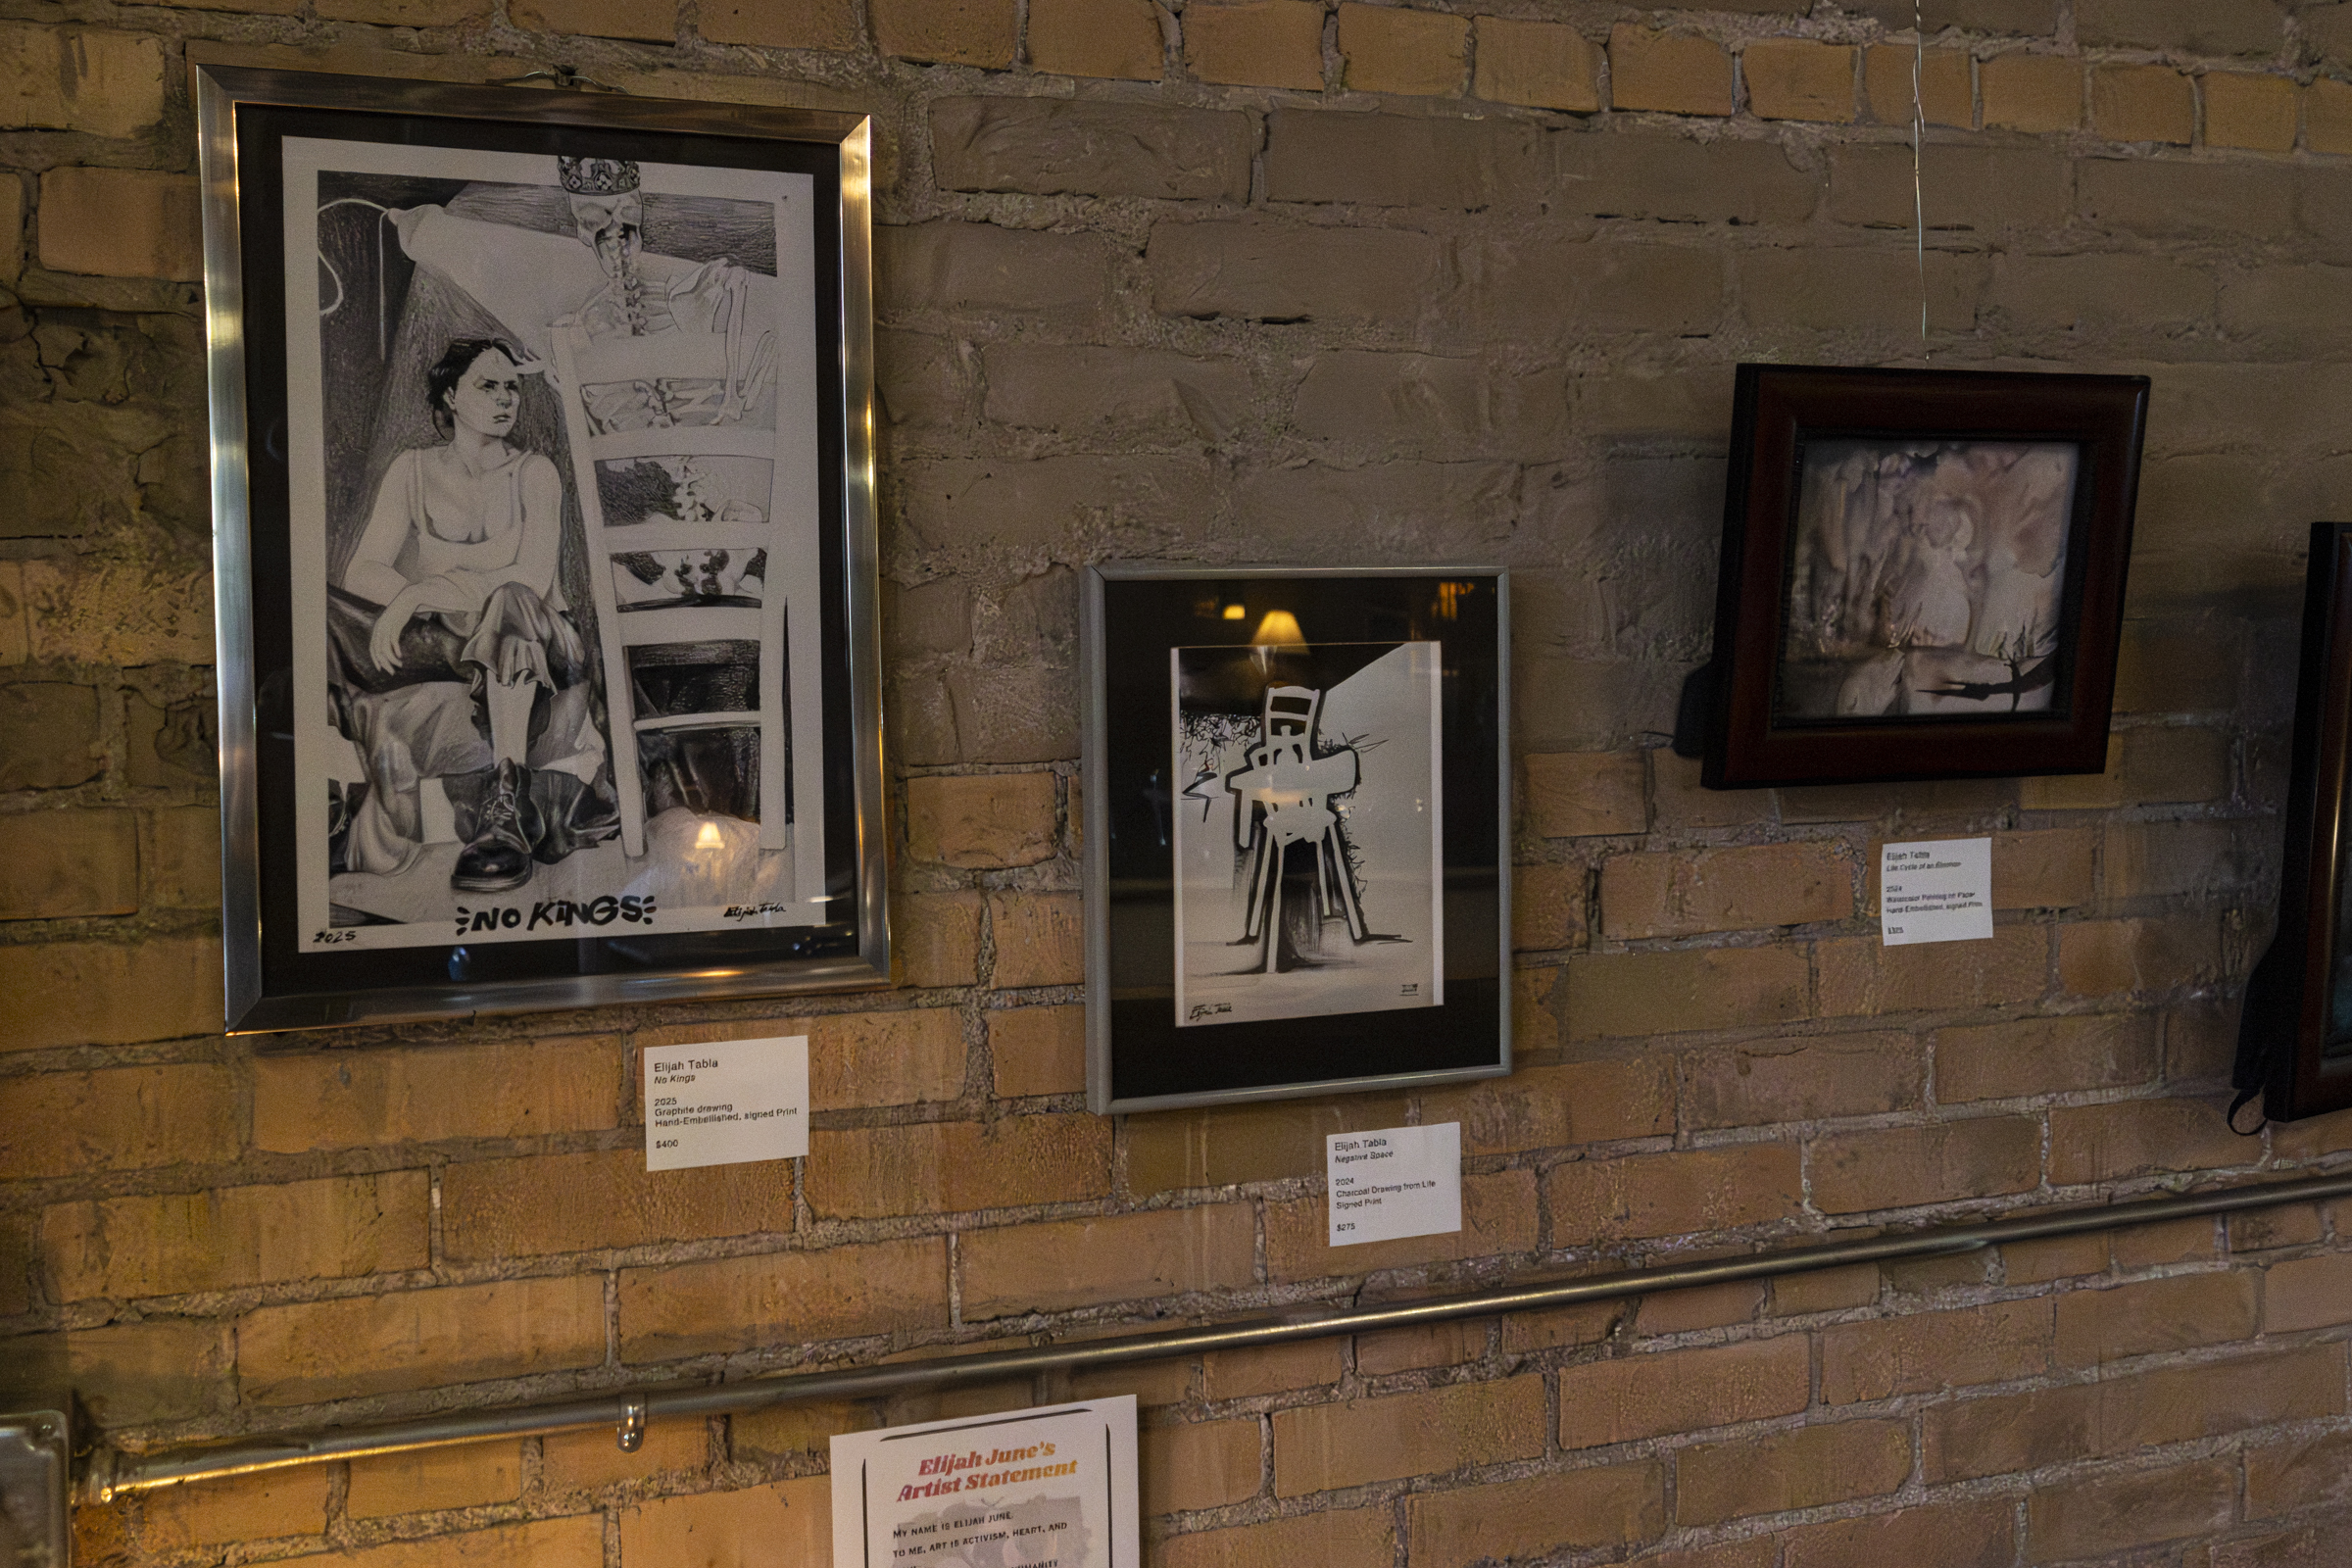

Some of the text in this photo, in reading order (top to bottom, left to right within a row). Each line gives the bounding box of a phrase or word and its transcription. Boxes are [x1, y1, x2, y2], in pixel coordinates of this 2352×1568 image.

[470, 907, 521, 932] NO
[313, 930, 357, 945] 2025
[654, 1058, 718, 1074] Elijah Tabla
[670, 1074, 696, 1084] Kings
[655, 1098, 678, 1106] 2025
[655, 1103, 733, 1117] Graphite drawing
[744, 1109, 774, 1121] signed
[776, 1107, 798, 1116] Print
[656, 1139, 678, 1149] $400
[1335, 1139, 1388, 1152] Elijah Tabla
[1335, 1151, 1394, 1163] Negative Space
[1336, 1188, 1370, 1198] Charcoal
[1372, 1184, 1401, 1195] Drawing
[1336, 1198, 1382, 1210] Signed Print
[1337, 1223, 1356, 1232] $275
[918, 1441, 1056, 1476] Elijah June's
[896, 1459, 1078, 1502] Artist Statement
[893, 1529, 907, 1540] MY
[910, 1523, 938, 1537] NAME
[941, 1521, 951, 1531] IS
[954, 1516, 985, 1529] ELIJAH
[893, 1548, 906, 1558] TO
[929, 1542, 947, 1552] ART
[951, 1539, 959, 1548] IS
[962, 1531, 1010, 1546] ACTIVISM,
[1012, 1525, 1046, 1538] HEART,
[1048, 1521, 1068, 1533] AND
